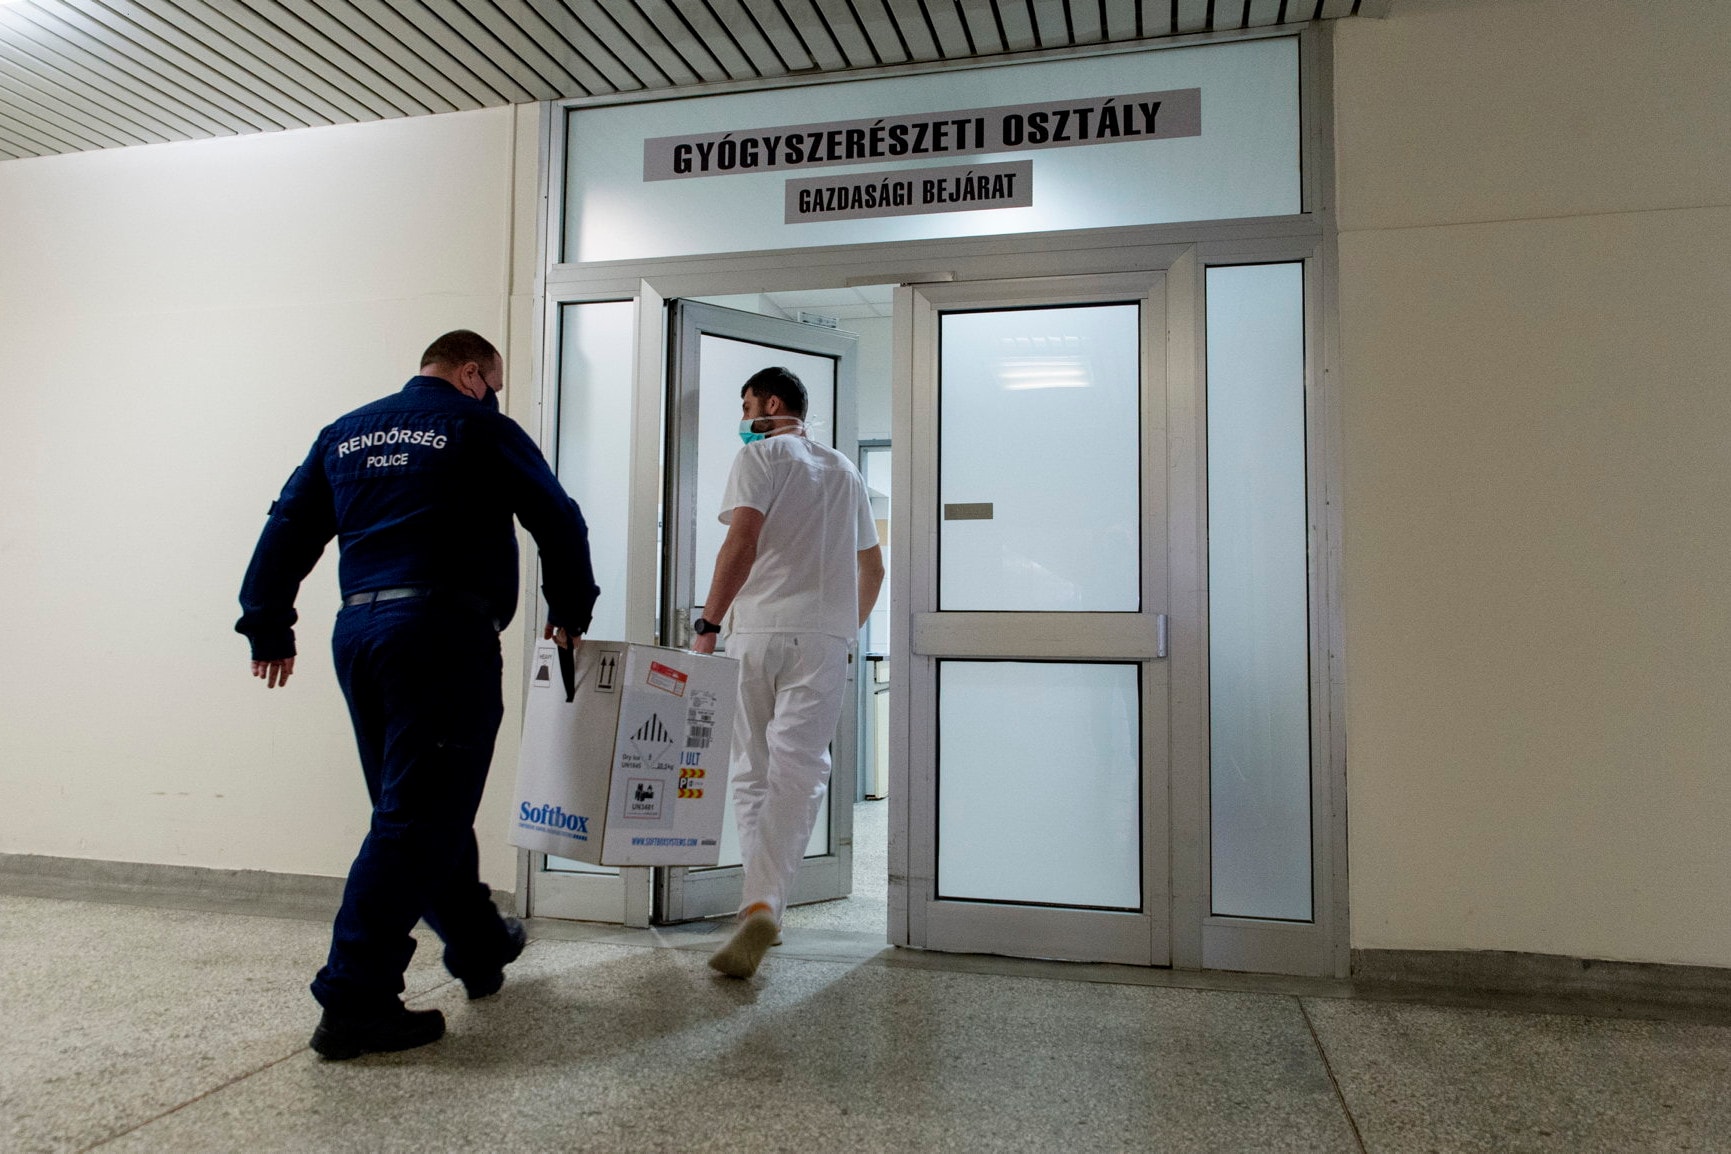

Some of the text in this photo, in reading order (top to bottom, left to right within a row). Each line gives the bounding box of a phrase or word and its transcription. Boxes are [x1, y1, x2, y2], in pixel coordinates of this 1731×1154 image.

[673, 97, 1163, 174] GYÓGYSZERÉSZETI OSZTÁLY
[799, 170, 1017, 214] GAZDASÁGI BEJÁRAT
[337, 427, 448, 459] RENDŐRSÉG
[366, 453, 409, 469] POLICE
[686, 751, 701, 765] ULT
[519, 800, 589, 833] Softbox
